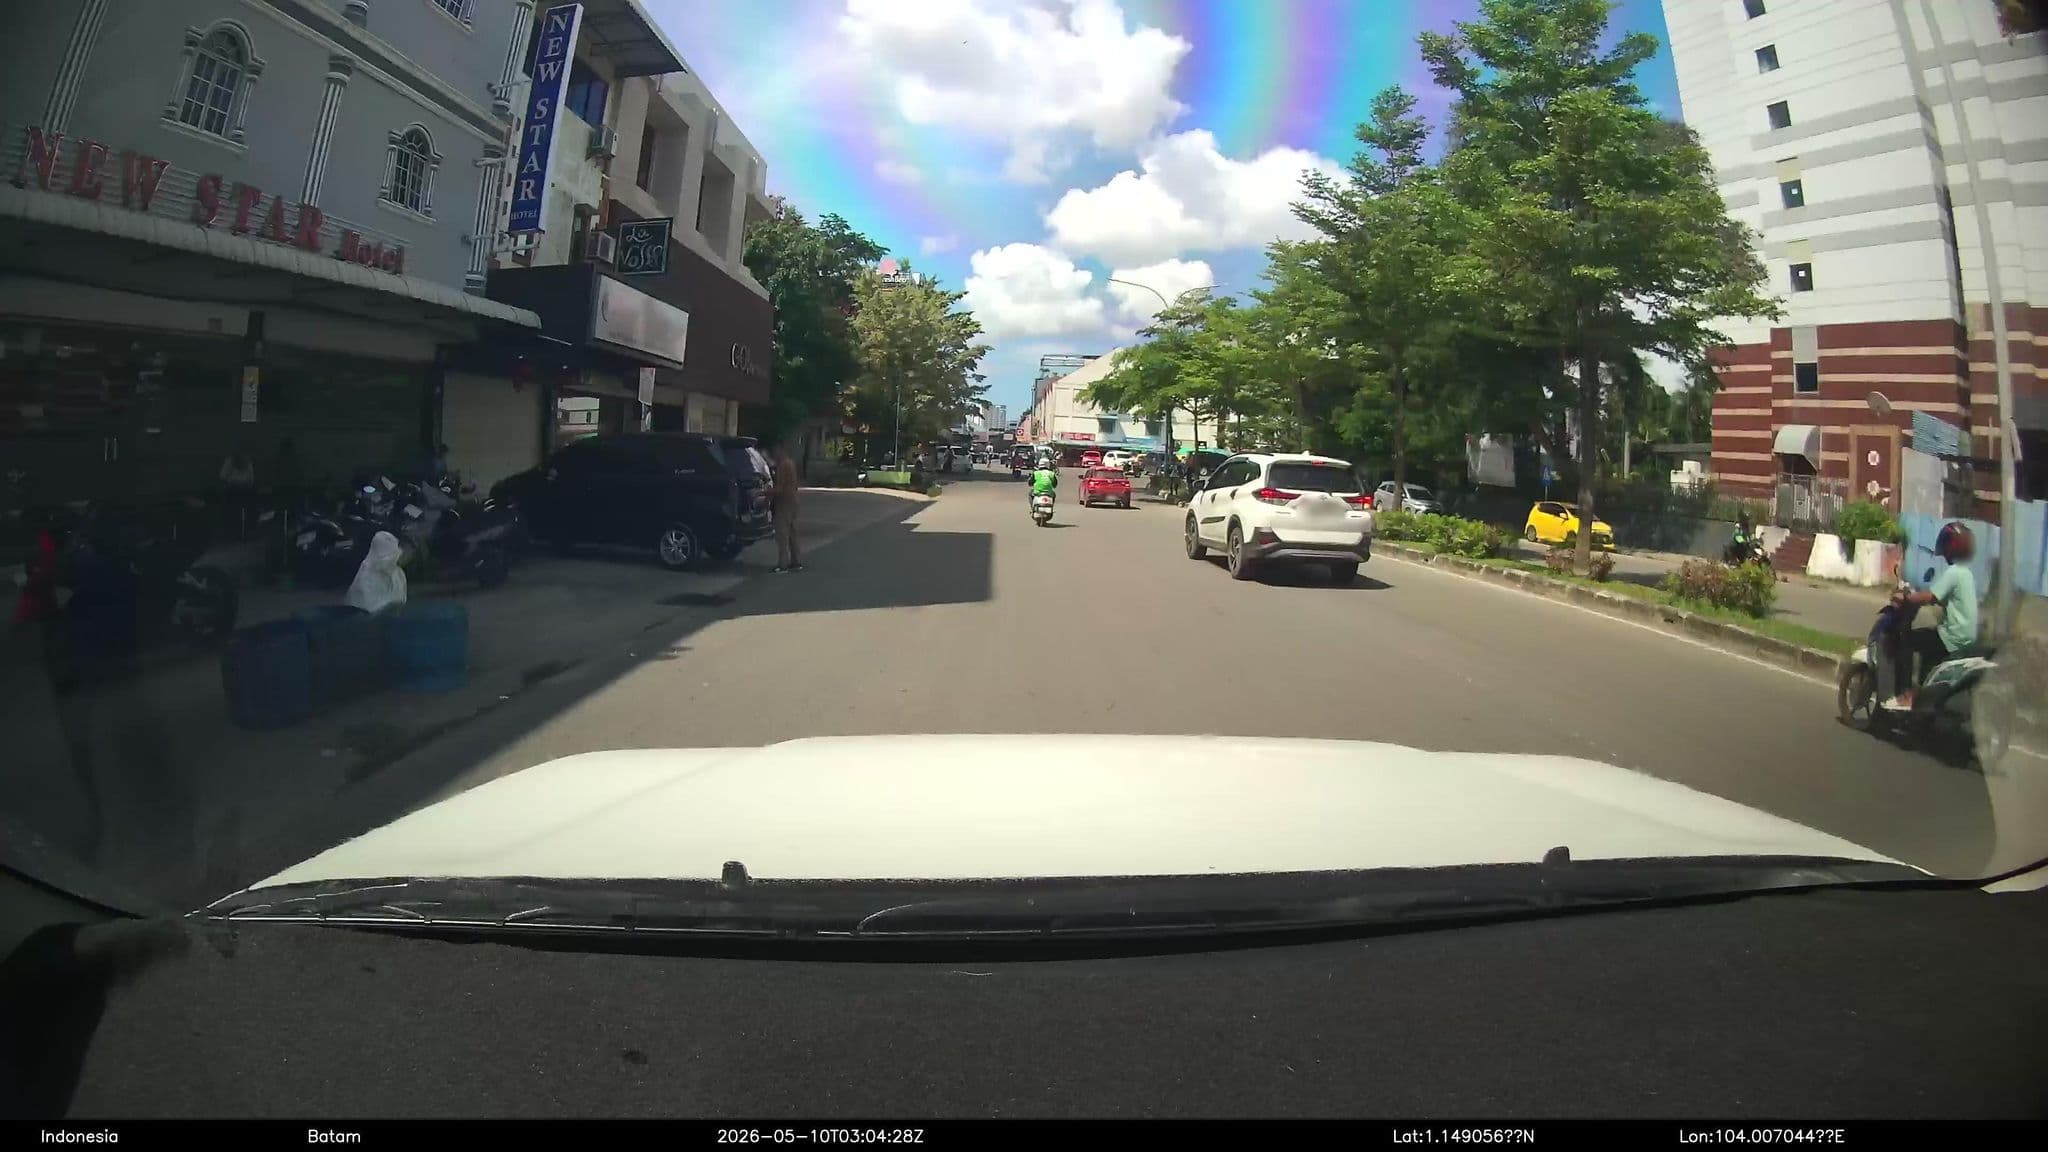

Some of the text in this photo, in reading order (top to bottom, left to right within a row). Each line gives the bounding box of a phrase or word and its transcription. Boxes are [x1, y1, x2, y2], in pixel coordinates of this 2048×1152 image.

[519, 12, 571, 201] NEW STAR
[15, 126, 405, 275] NEW STAR Hotel
[510, 208, 538, 221] HOTEL
